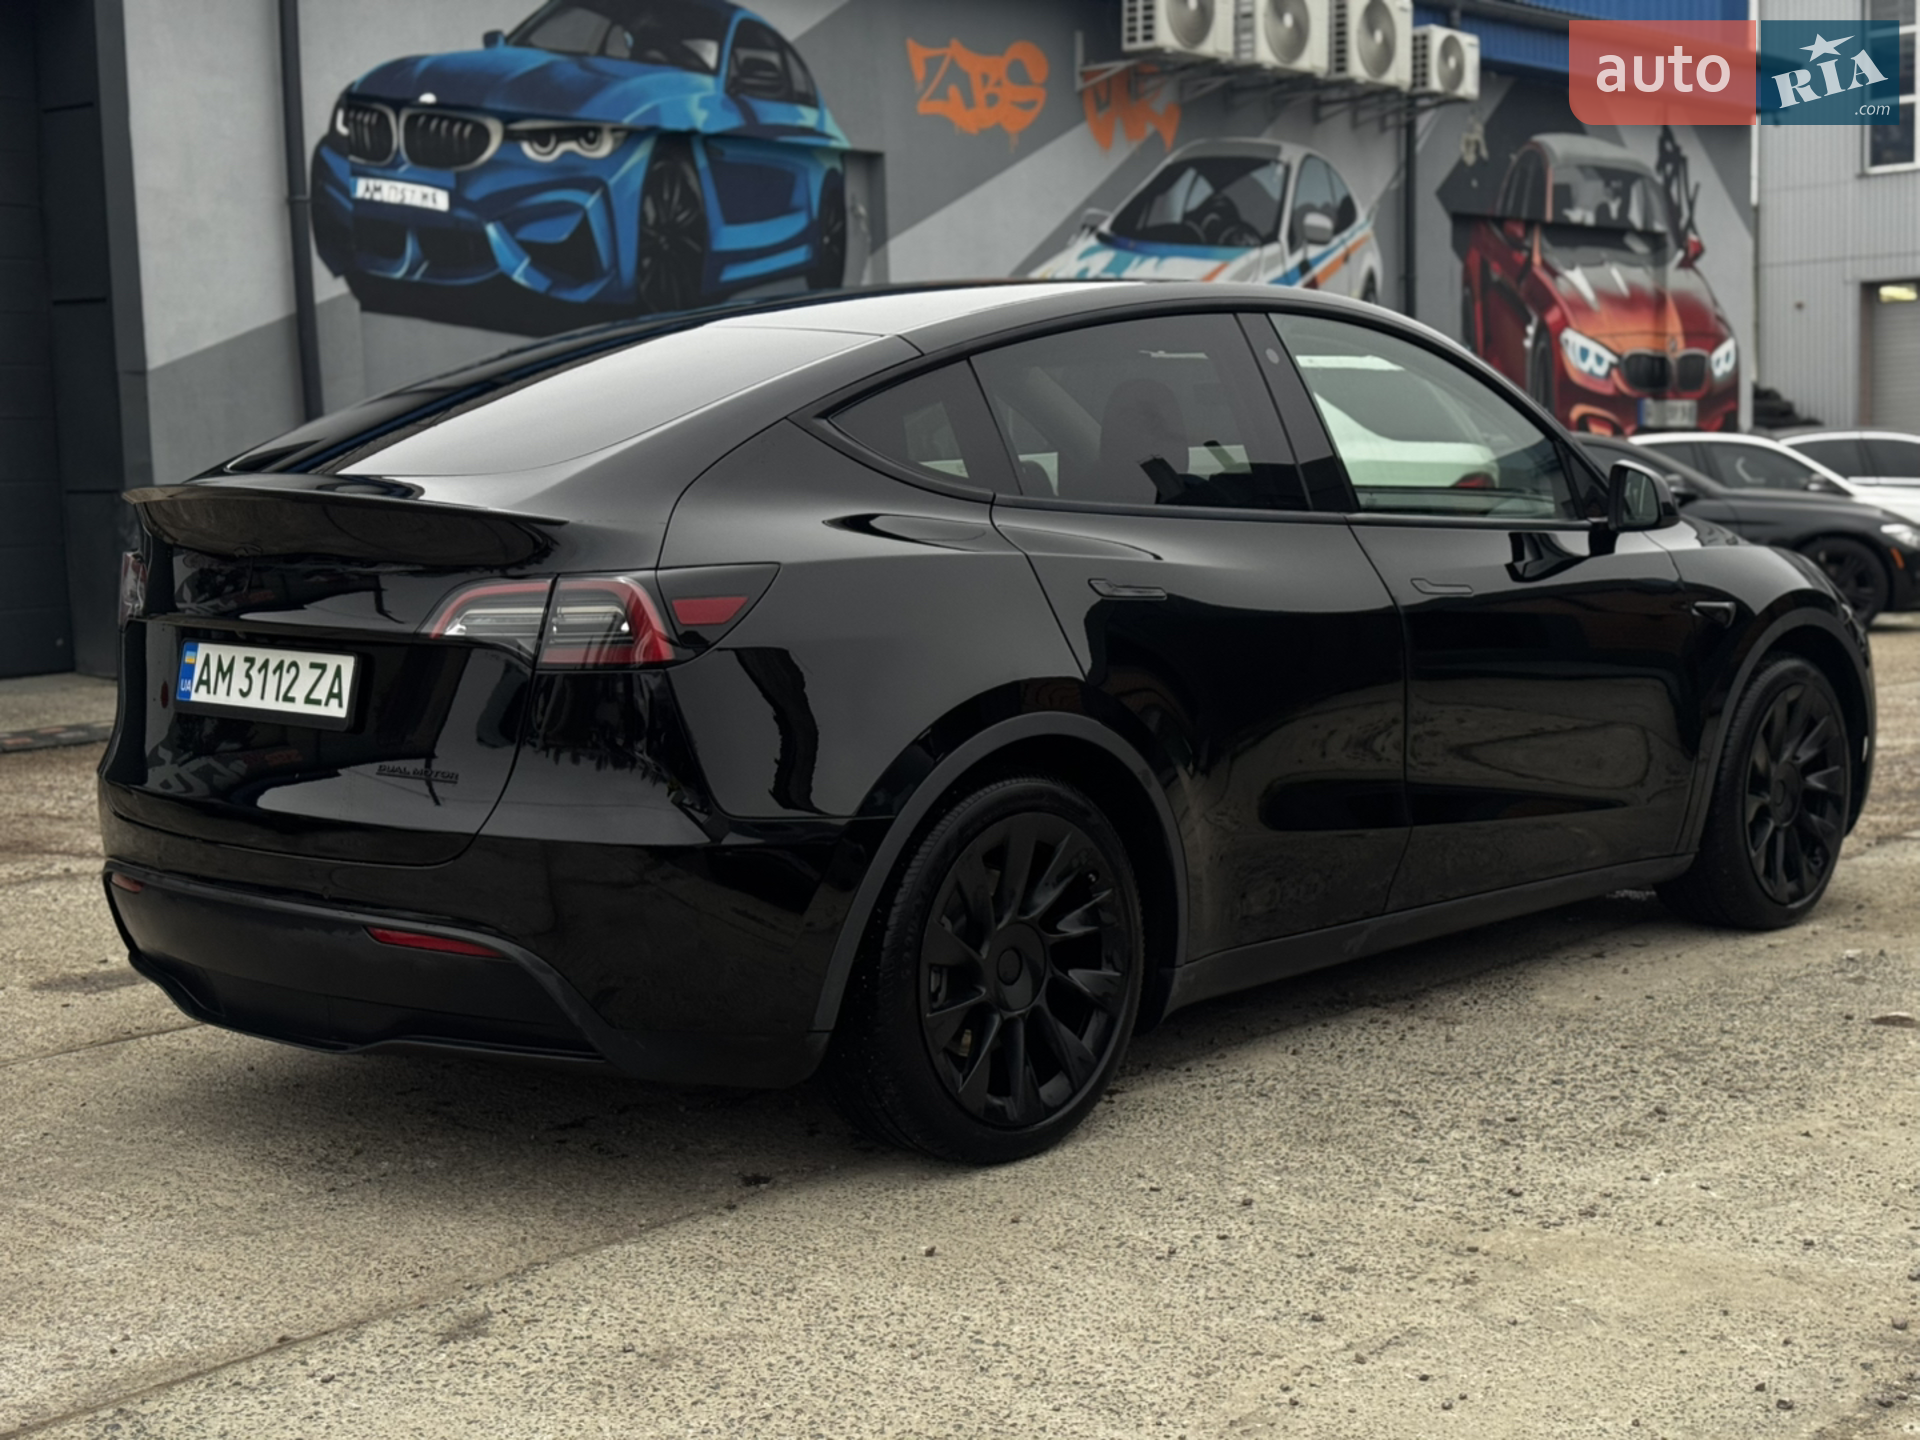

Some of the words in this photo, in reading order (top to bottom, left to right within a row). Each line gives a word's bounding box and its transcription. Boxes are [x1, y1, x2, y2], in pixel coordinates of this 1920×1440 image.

[180, 678, 192, 692] UA
[194, 652, 236, 697] AM
[238, 656, 300, 704] 3112
[303, 661, 343, 708] ZA
[377, 764, 410, 776] DUAL
[412, 768, 459, 780] MOTOR
